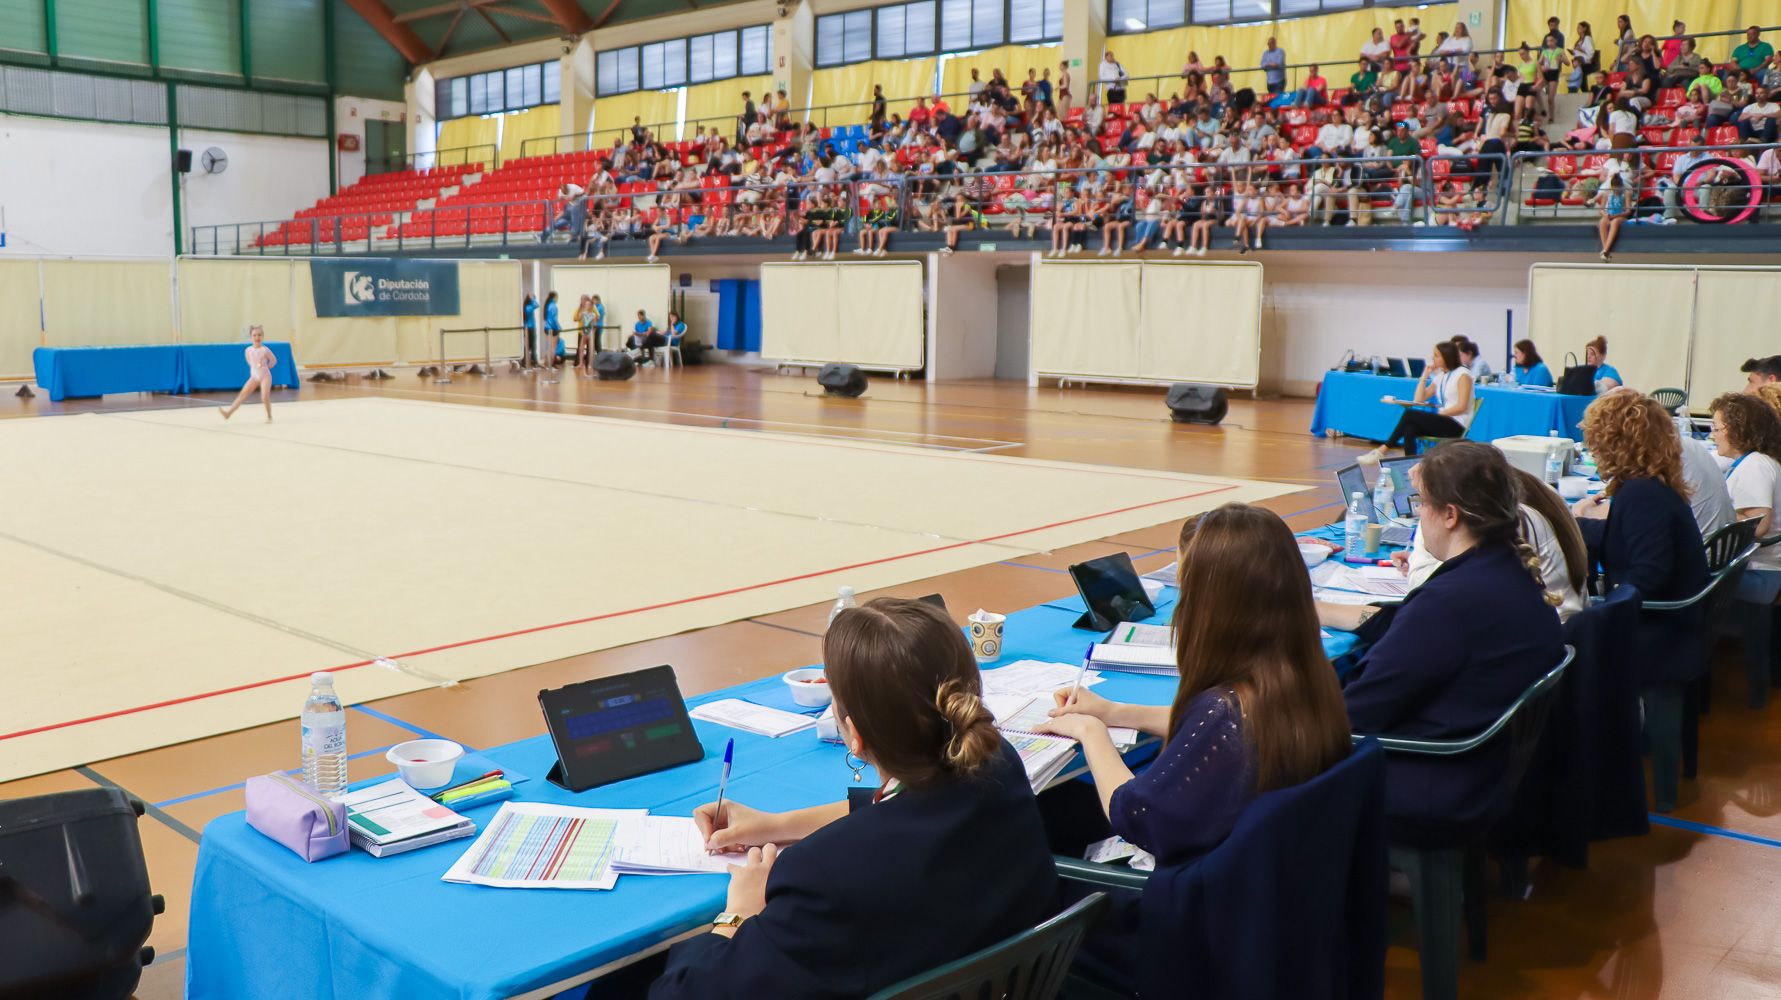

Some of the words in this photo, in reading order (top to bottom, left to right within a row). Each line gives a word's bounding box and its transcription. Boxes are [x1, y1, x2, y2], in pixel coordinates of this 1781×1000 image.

[378, 278, 429, 291] Diputación
[379, 290, 391, 300] de
[393, 290, 429, 300] Córdoba
